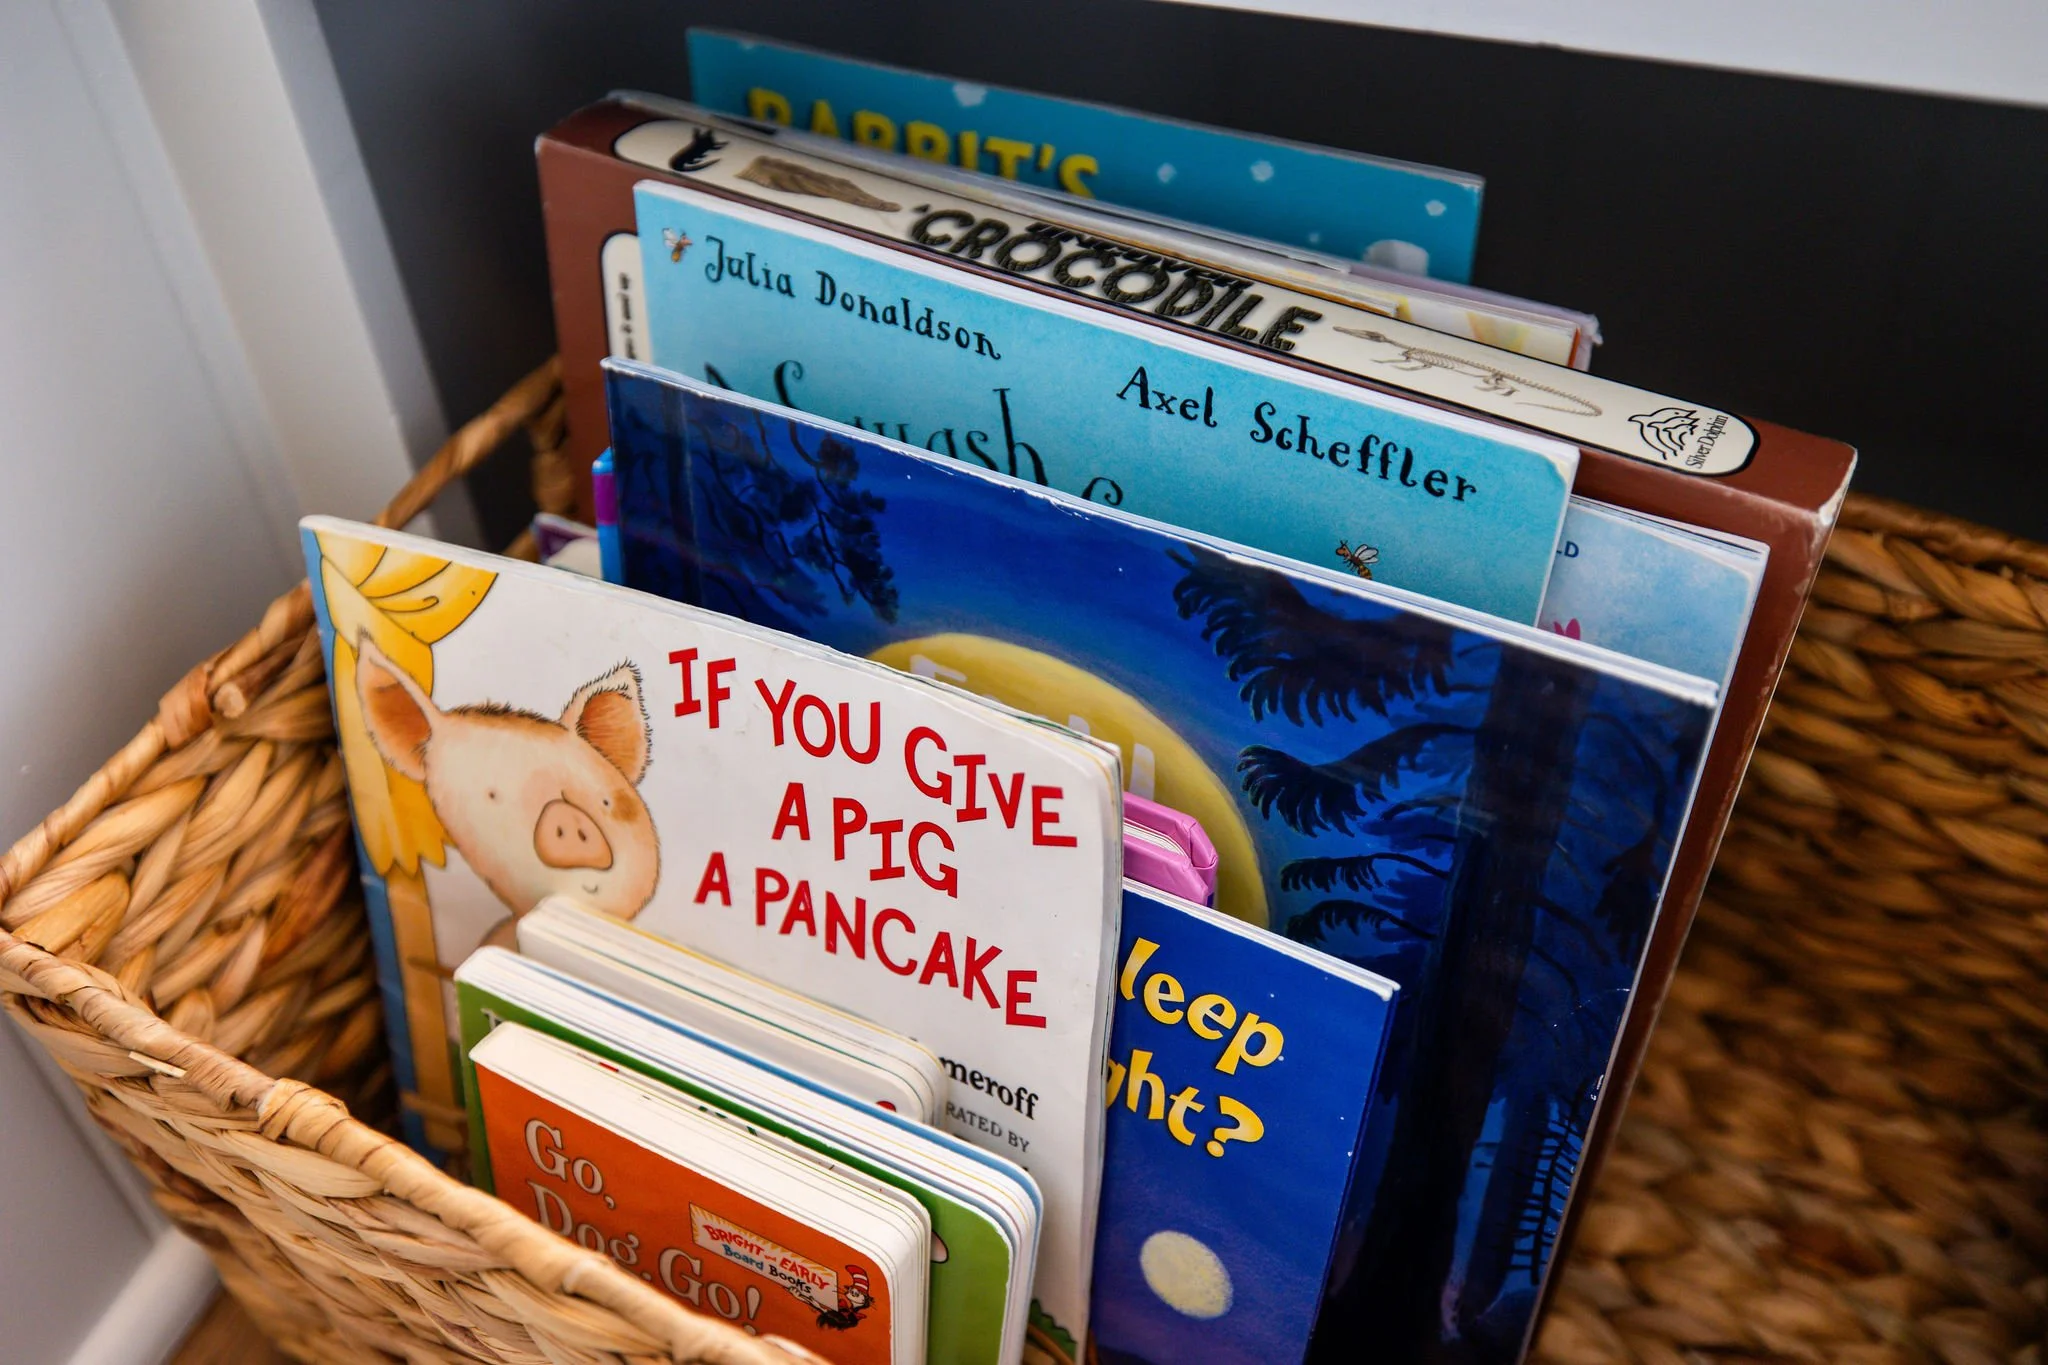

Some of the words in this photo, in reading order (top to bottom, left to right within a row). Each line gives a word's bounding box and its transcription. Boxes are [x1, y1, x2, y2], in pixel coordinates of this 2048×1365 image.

[705, 235, 796, 298] Julia
[814, 271, 1001, 360] Donaldson
[1117, 366, 1218, 428] Axel
[1251, 402, 1477, 502] Scheffler
[669, 648, 736, 728] IF
[755, 679, 881, 764] YOU
[904, 726, 1078, 848] GIVE
[771, 782, 810, 840] A
[833, 797, 958, 899] PIG
[693, 852, 732, 907] A
[755, 868, 1047, 1029] PANCAKE
[525, 1118, 616, 1210] Go,
[1007, 1130, 1030, 1152] BY
[659, 1248, 762, 1337] Go!
[702, 1224, 765, 1257] BRIGHT
[779, 1257, 831, 1290] EARLY
[722, 1243, 765, 1272] Board
[768, 1264, 812, 1294] Books
